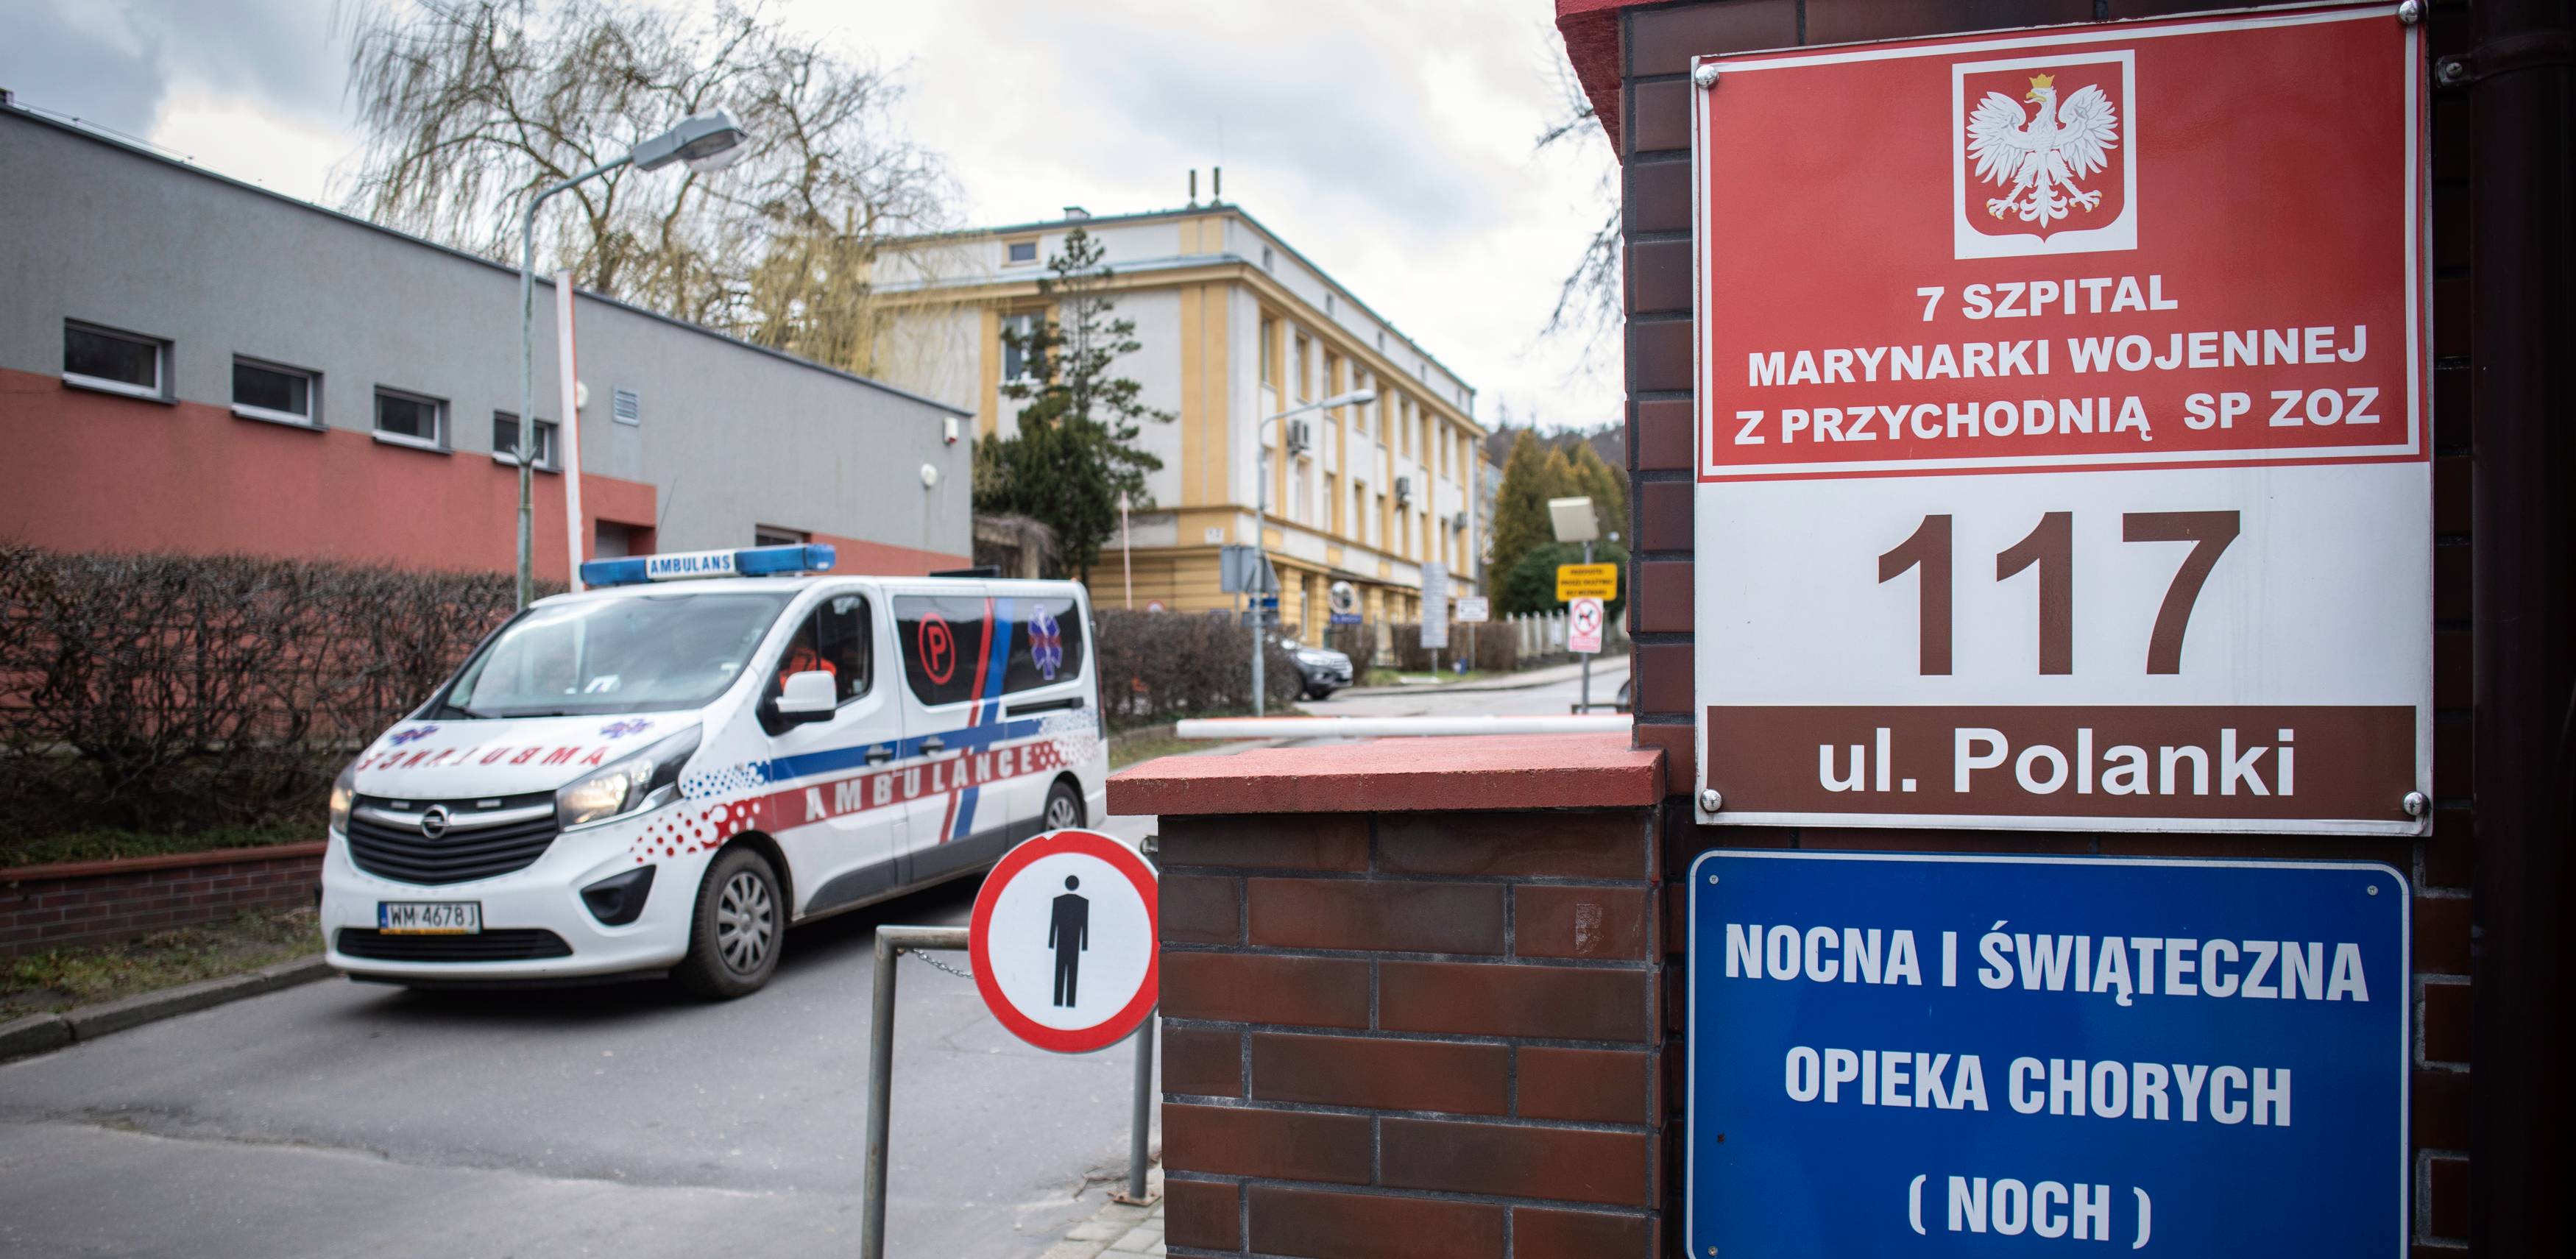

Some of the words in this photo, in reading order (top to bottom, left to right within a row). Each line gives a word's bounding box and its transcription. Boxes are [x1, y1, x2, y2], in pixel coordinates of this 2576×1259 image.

[1917, 286, 1945, 322] 7
[1961, 274, 2179, 320] SZPITAL
[1748, 338, 2050, 387] MARYNARKI
[2067, 324, 2368, 375] WOJENNEJ
[1734, 410, 1766, 445] Z
[1781, 395, 2154, 444] PRZYCHODNIĄ
[2184, 391, 2252, 430] SP
[2268, 386, 2381, 428] ZOZ
[651, 554, 731, 574] AMBULANS
[1878, 510, 2241, 676] 117
[804, 745, 1034, 823] AMBULANCE
[1819, 727, 1918, 793] ul.
[1953, 727, 2295, 797] Polanki
[391, 907, 415, 926] WM
[422, 906, 475, 927] 4678J
[1726, 923, 1922, 986] NOCNA
[1942, 932, 1958, 987] I
[1978, 920, 2370, 1007] ŚWIĄTECZNA
[1786, 1046, 1989, 1112] OPIEKA
[2009, 1056, 2292, 1127] CHORYCH
[1948, 1177, 2111, 1242] NOCH
